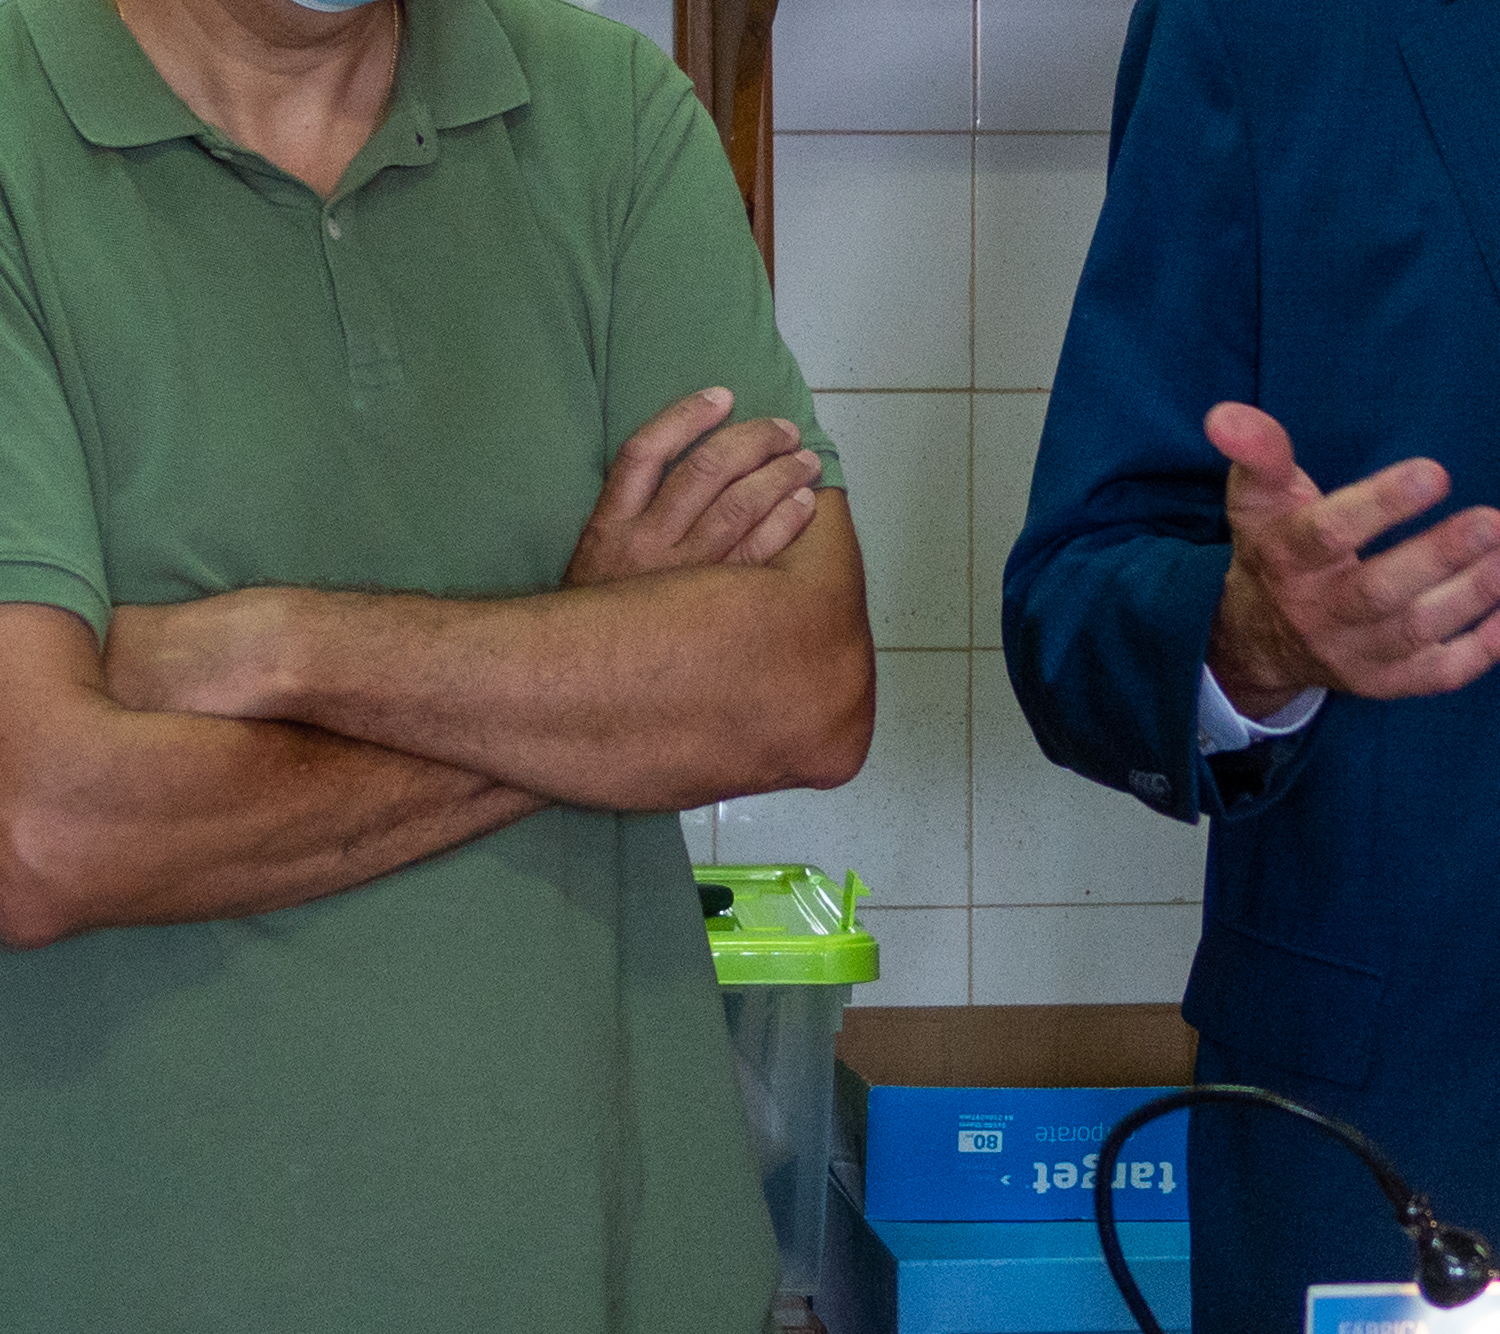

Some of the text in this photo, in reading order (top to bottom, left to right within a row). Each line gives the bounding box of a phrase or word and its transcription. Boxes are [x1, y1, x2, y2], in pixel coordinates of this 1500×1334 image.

[972, 1133, 999, 1150] 80
[1034, 1121, 1135, 1143] porate
[1033, 1153, 1177, 1194] target
